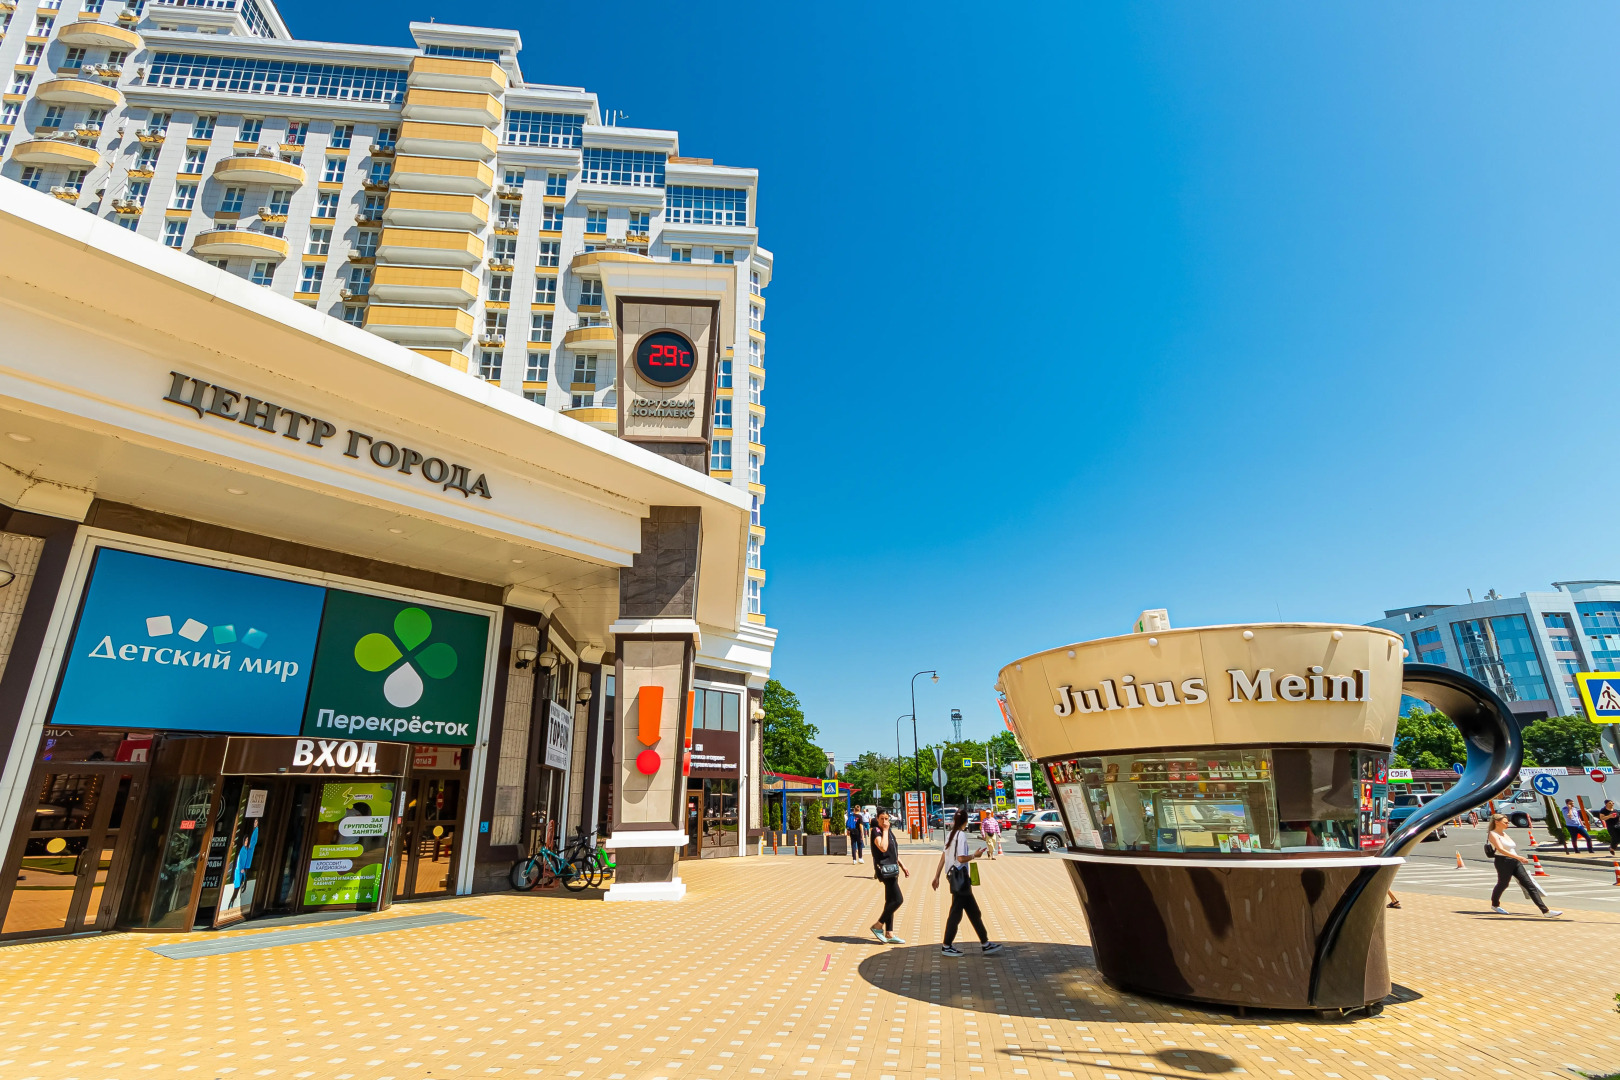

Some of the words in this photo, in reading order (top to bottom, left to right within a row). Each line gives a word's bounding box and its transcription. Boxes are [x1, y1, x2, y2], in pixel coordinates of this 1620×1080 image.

[632, 408, 695, 419] КОМПЛЕКС
[633, 398, 695, 409] ТОРГОВЫЙ
[163, 371, 337, 448] ЦЕНТР
[343, 430, 492, 499] ГОРОДА
[88, 635, 232, 671] Детский
[239, 656, 299, 682] мир
[1054, 674, 1208, 717] Julius
[1225, 665, 1372, 703] Meinl
[316, 709, 469, 737] Перекрёсток
[292, 740, 378, 773] ВХОД
